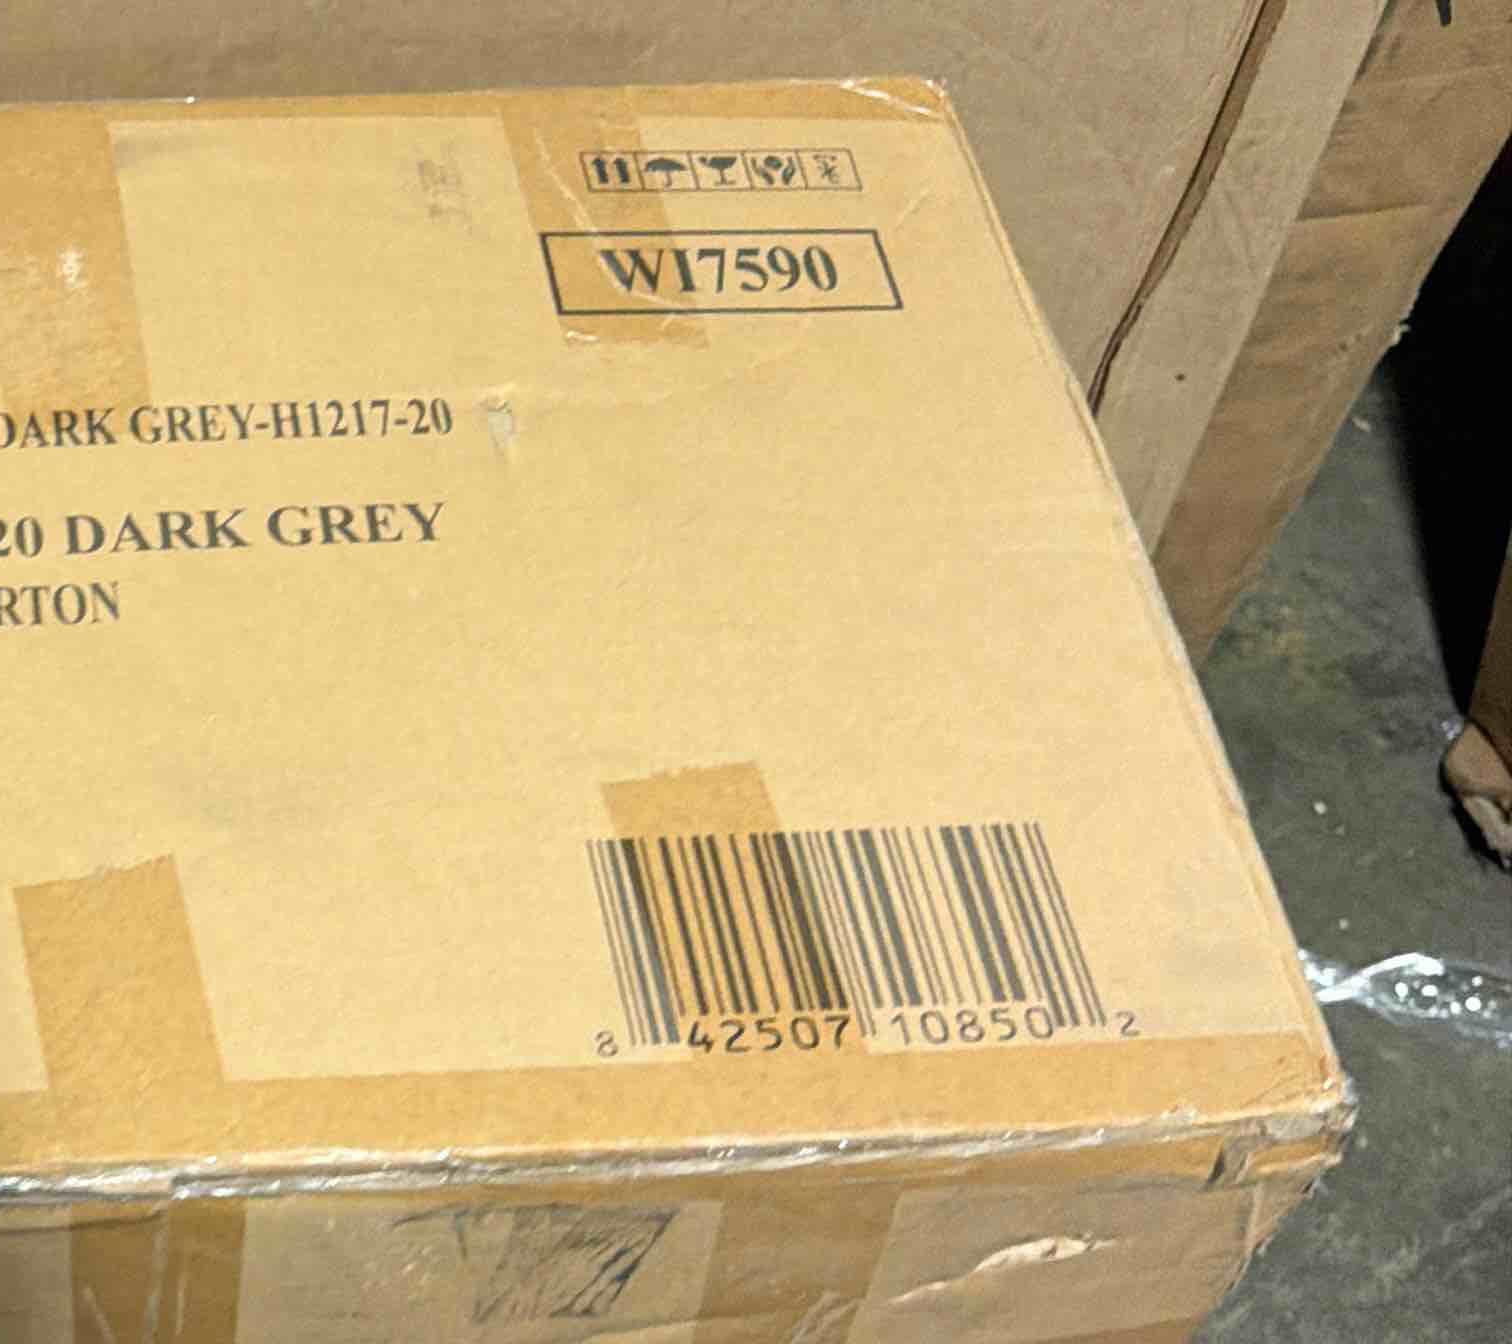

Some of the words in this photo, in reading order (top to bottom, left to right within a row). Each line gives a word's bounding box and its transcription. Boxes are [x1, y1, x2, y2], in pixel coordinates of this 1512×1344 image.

[599, 244, 839, 294] WI7590
[128, 397, 455, 445] GREY-H1217-20
[63, 506, 254, 557] DARK
[265, 500, 446, 548] GREY
[687, 1013, 852, 1055] 42507
[889, 1004, 1056, 1047] 10850
[1117, 1009, 1142, 1038] 2
